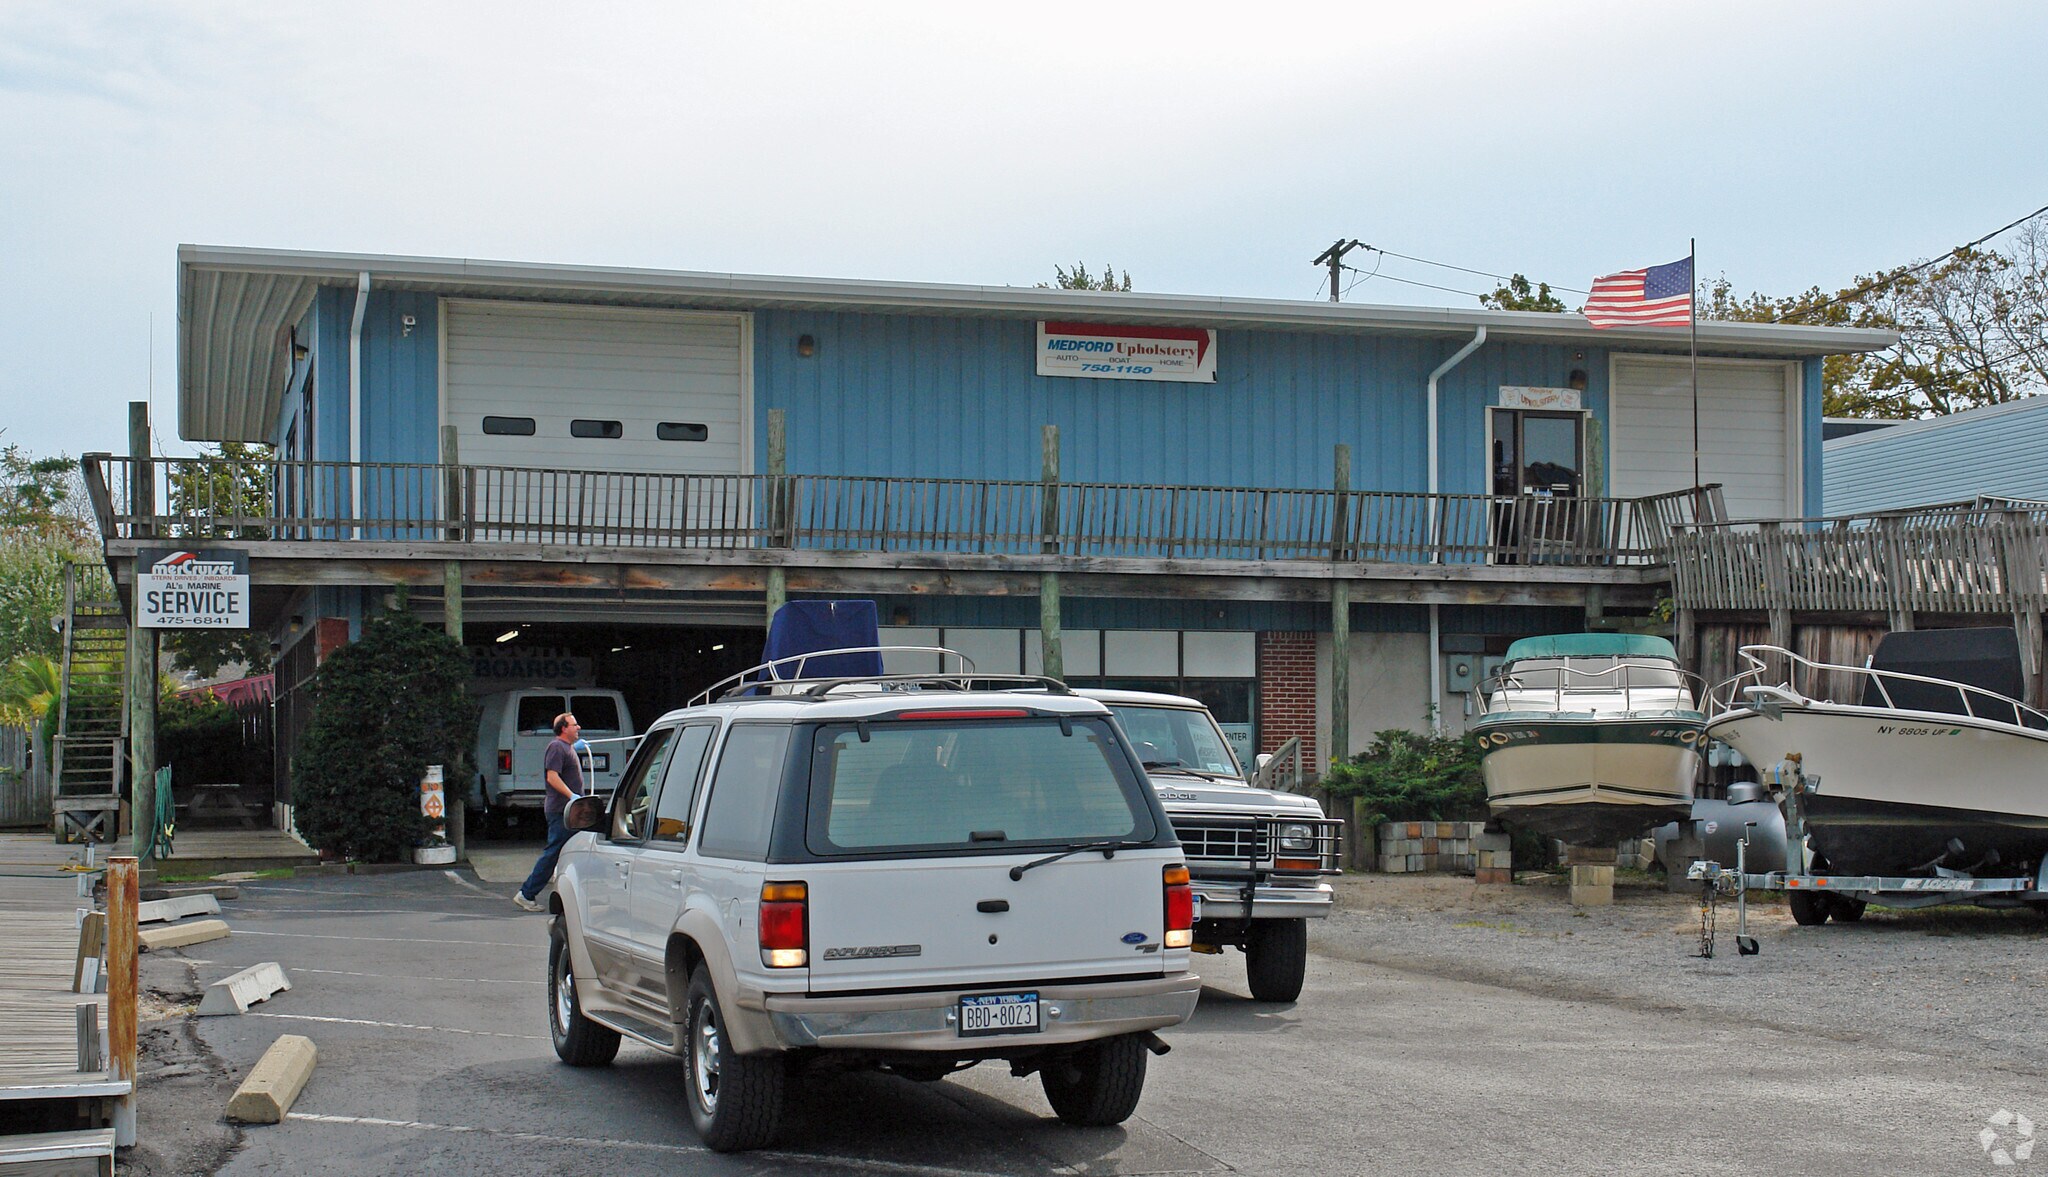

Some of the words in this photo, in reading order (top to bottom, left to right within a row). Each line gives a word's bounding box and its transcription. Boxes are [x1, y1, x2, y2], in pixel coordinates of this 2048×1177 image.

[1047, 339, 1114, 353] MEDFORD
[1116, 342, 1197, 358] Upholstery
[1056, 354, 1079, 362] AUTO
[1109, 356, 1131, 364] BOAT
[1160, 359, 1184, 367] HOME
[165, 582, 183, 590] AL's
[187, 582, 222, 590] MARINE
[146, 591, 239, 614] SERVICE
[156, 616, 230, 625] 475-6841
[474, 658, 577, 682] BOARDS
[1877, 725, 1896, 735] NY
[1898, 727, 1929, 736] 8805
[1931, 728, 1948, 736] UF
[1224, 732, 1247, 741] ENTER
[1157, 792, 1197, 800] ODGE
